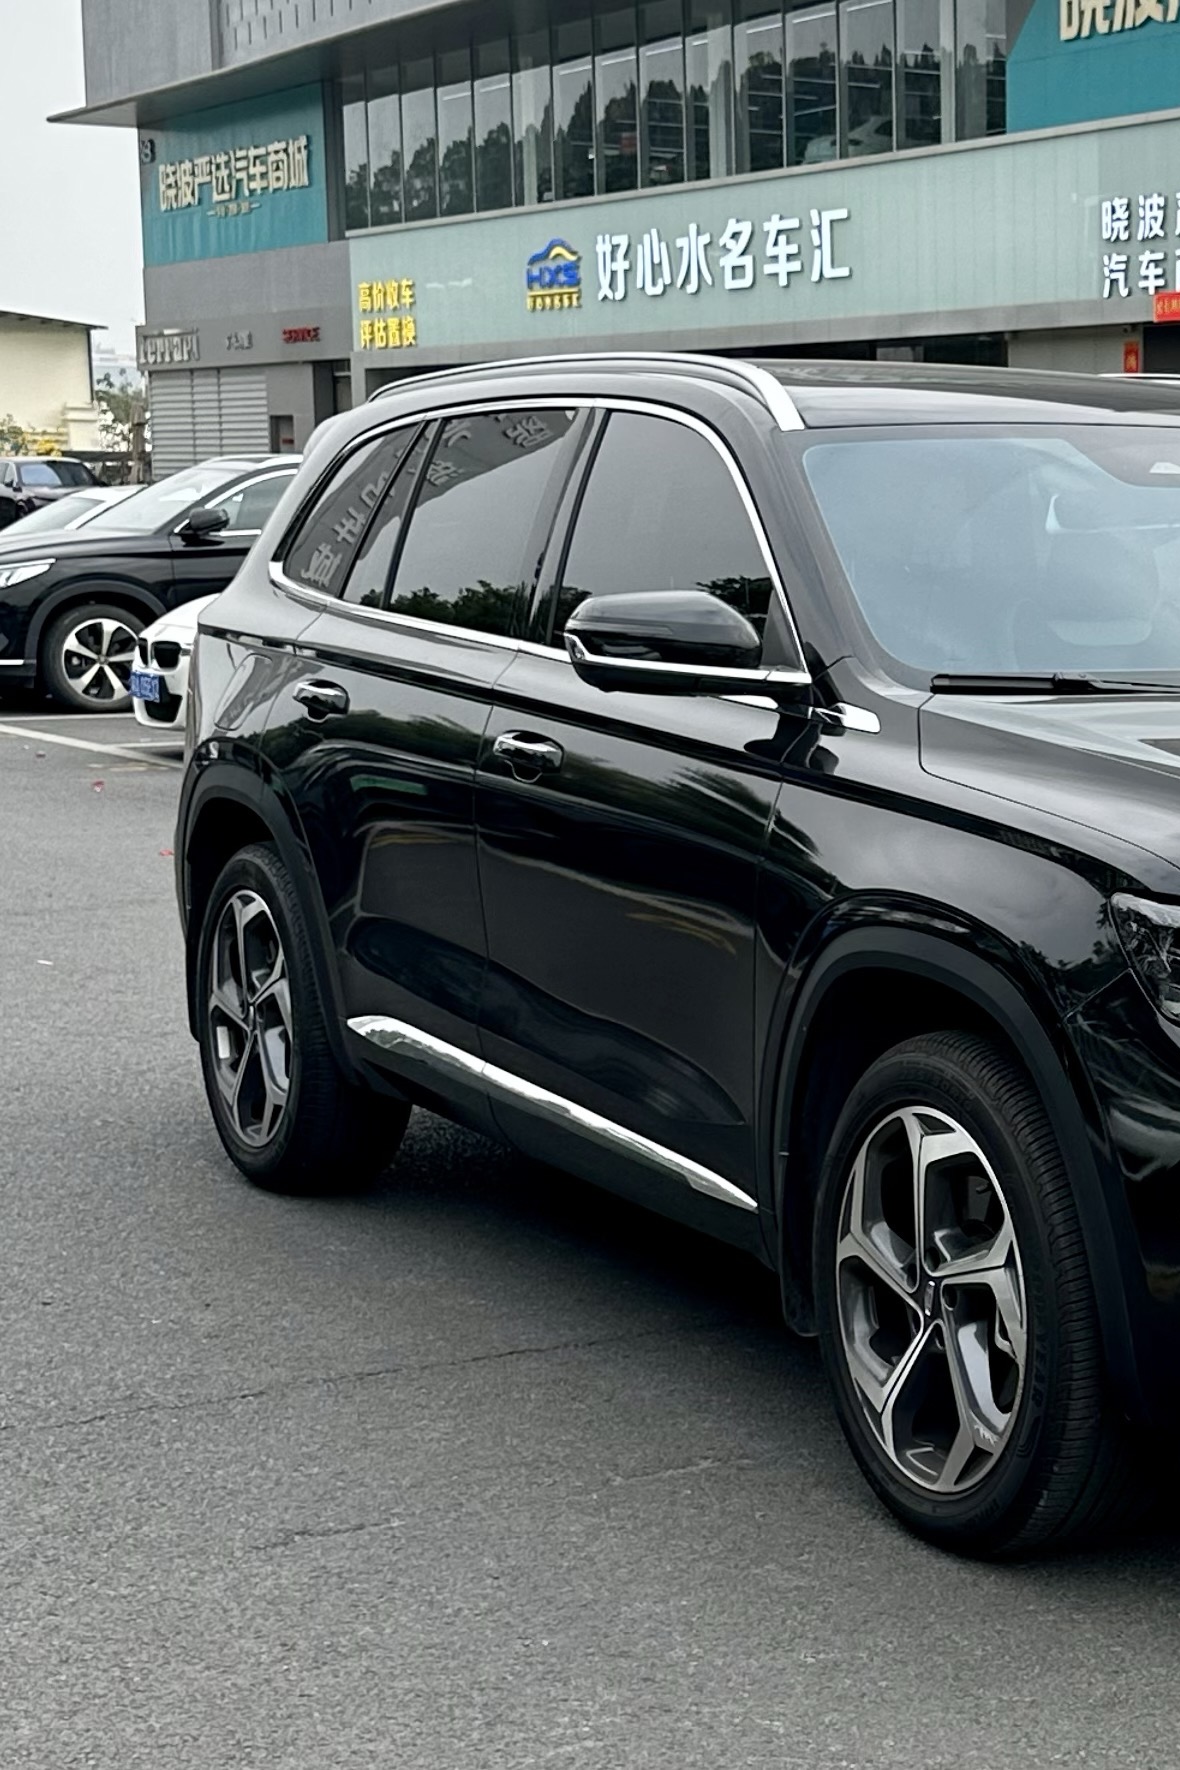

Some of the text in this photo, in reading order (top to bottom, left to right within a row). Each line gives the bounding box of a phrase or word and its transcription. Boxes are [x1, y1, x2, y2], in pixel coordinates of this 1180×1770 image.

[158, 135, 310, 212] 晓波严选汽车商城
[595, 208, 850, 302] 好心水名车汇
[358, 278, 415, 312] 高价收车
[360, 315, 416, 349] 评估置换
